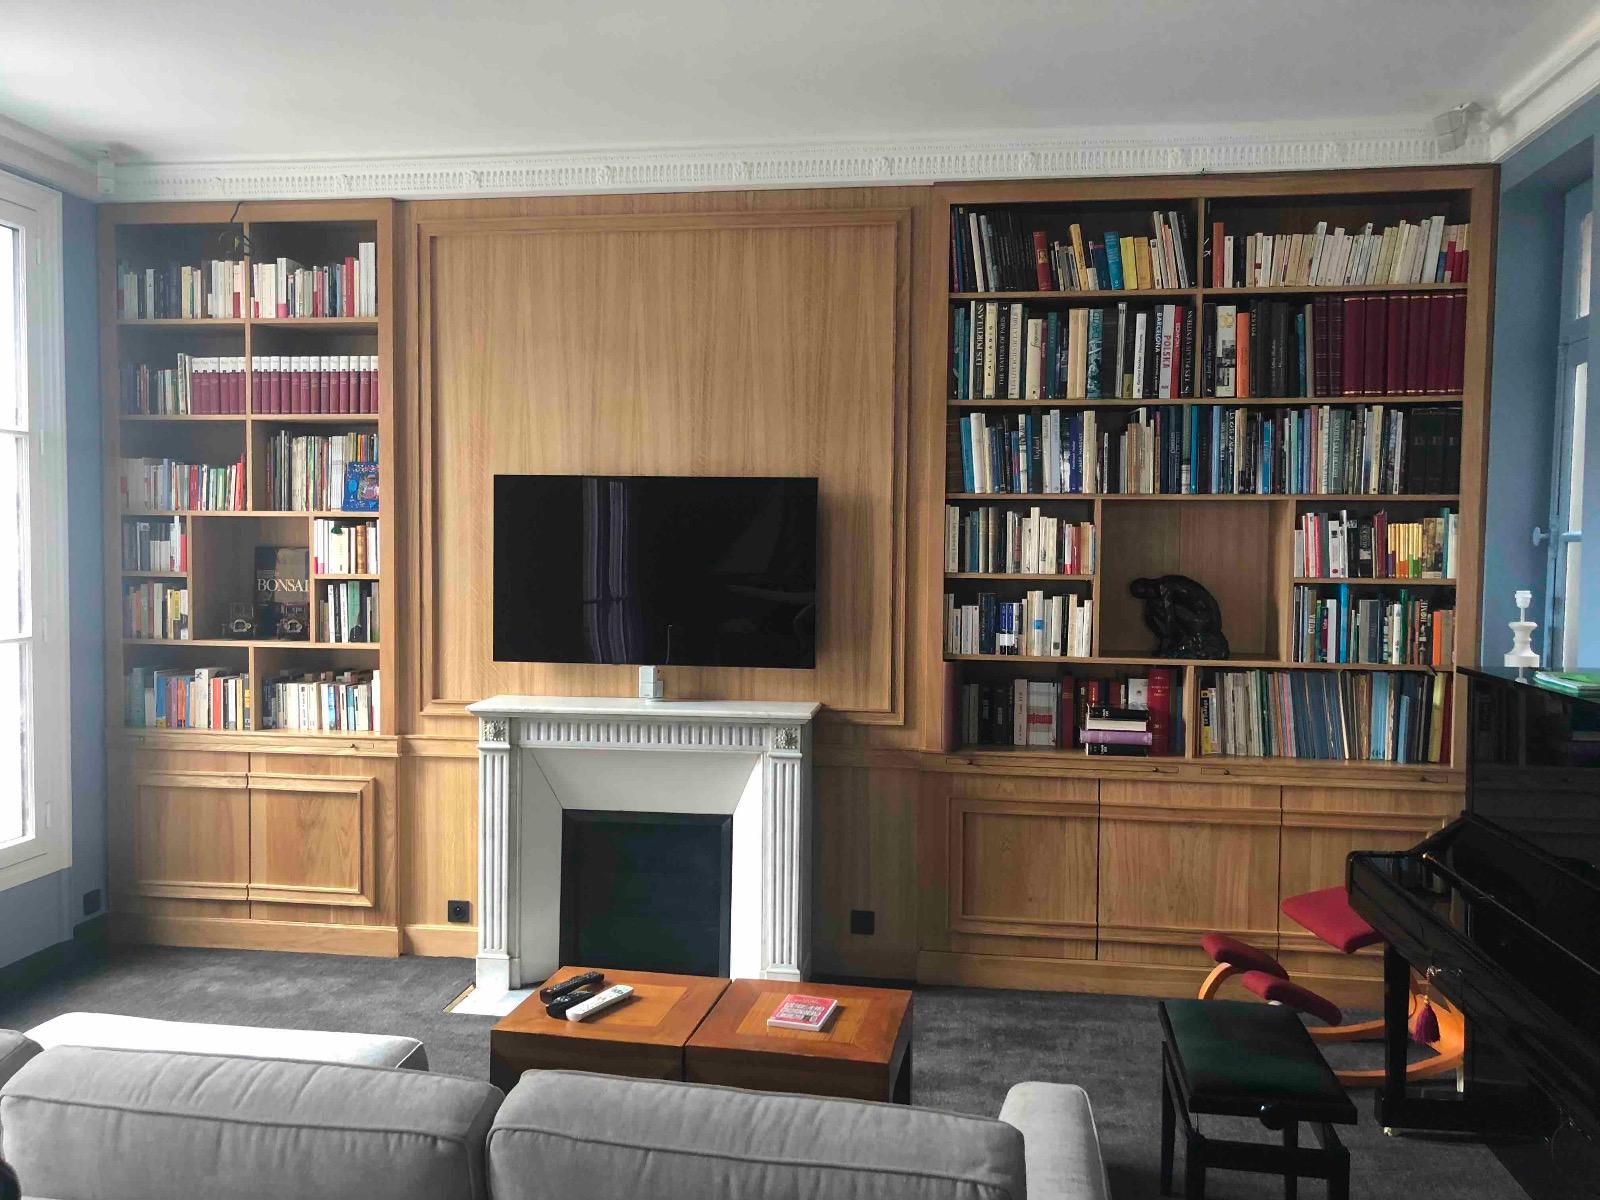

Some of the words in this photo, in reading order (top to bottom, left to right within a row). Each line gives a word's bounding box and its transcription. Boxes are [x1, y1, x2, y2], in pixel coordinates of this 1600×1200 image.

[975, 304, 984, 350] PORTULANS
[1154, 312, 1162, 353] BARCELONA
[975, 351, 983, 366] LES
[1161, 335, 1171, 369] POLSKA
[256, 578, 309, 592] BONSAI
[1308, 614, 1316, 634] CUBA
